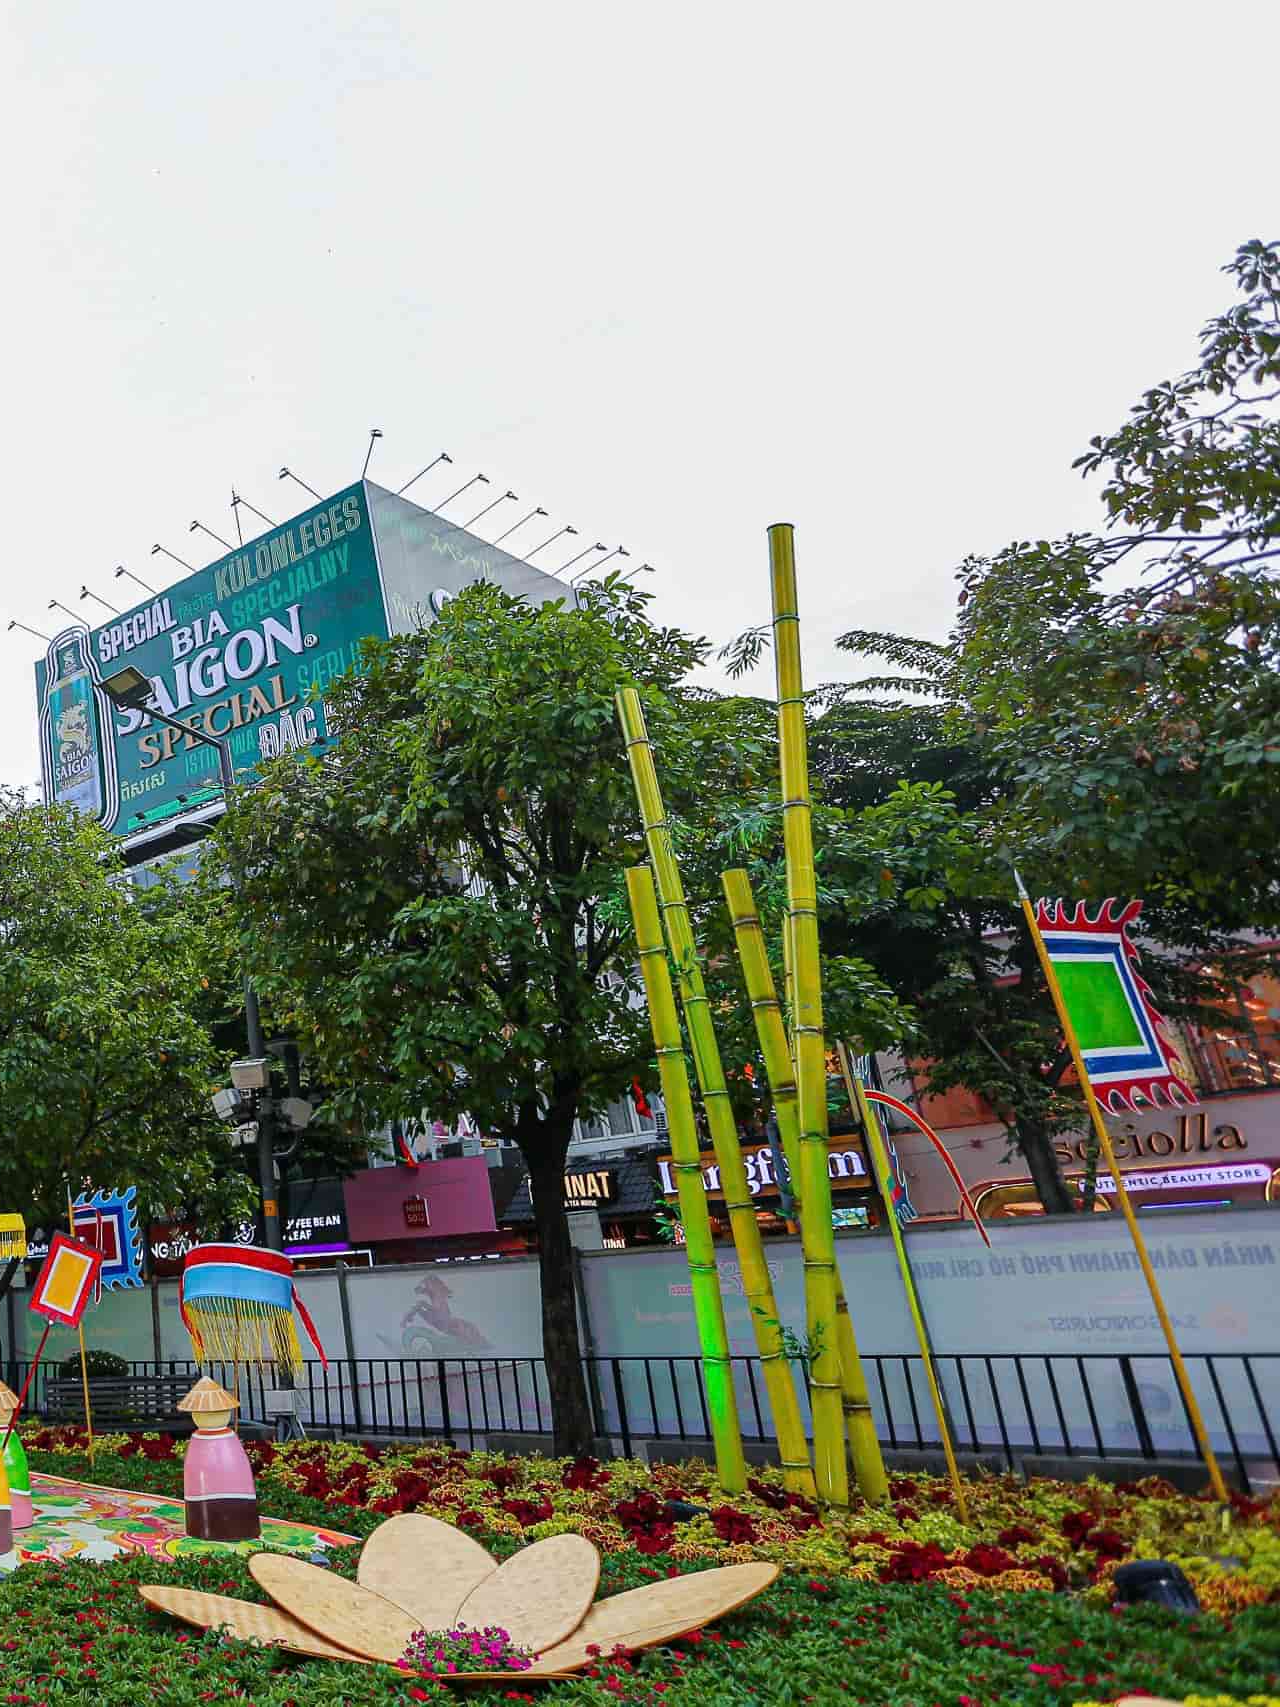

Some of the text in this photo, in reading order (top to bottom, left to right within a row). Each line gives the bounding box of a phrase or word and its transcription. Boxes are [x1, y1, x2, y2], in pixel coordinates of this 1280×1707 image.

[231, 541, 350, 628] SPECJALNY
[171, 610, 231, 660] BIA
[116, 603, 305, 737] SAIGON
[139, 674, 297, 769] SPECIAL
[1163, 1173, 1212, 1185] BEAUTY
[1217, 1168, 1263, 1180] STORE
[313, 1214, 341, 1228] BEAN
